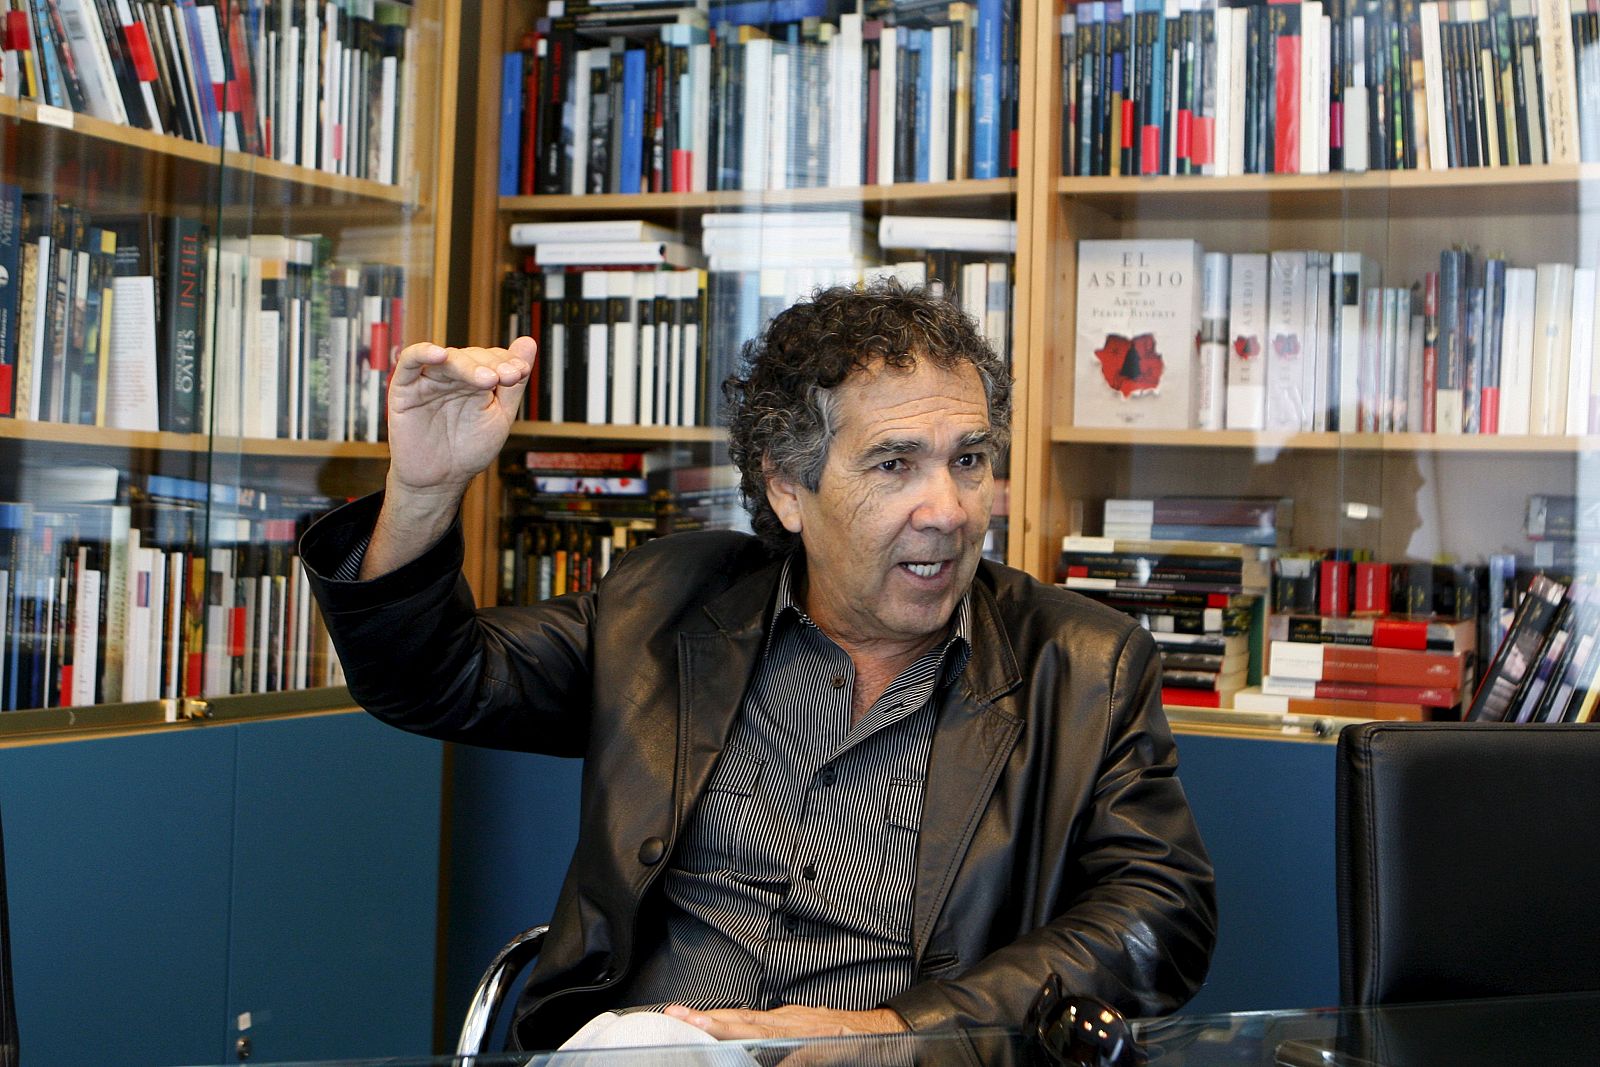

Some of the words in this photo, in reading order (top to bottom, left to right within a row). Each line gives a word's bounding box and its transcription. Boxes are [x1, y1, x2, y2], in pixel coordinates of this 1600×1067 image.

[180, 233, 198, 308] INFIEL
[1088, 271, 1183, 288] ASEDIO
[1123, 252, 1149, 268] EL
[181, 329, 196, 394] OATES
